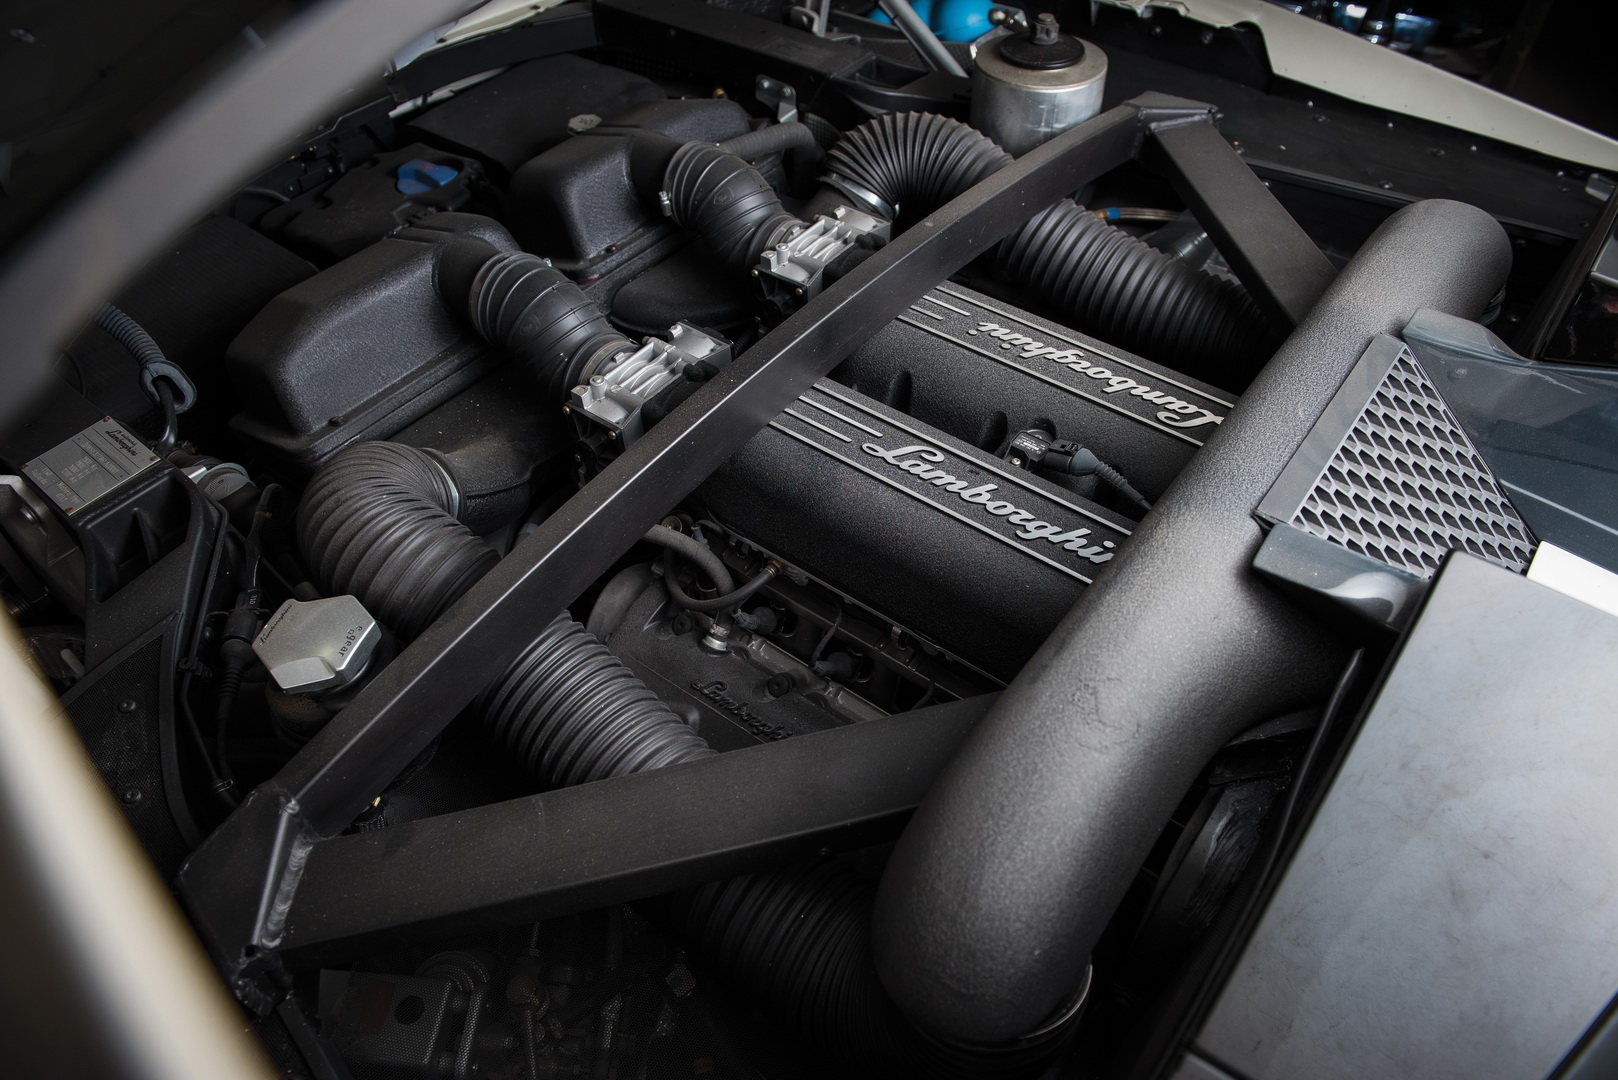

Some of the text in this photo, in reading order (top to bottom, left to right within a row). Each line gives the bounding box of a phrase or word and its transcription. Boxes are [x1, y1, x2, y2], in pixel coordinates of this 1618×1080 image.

[966, 321, 1225, 428] Lamborghini
[105, 430, 142, 457] Lamborghini
[861, 441, 1115, 564] Lamborghi
[691, 680, 794, 740] Lamborghi
